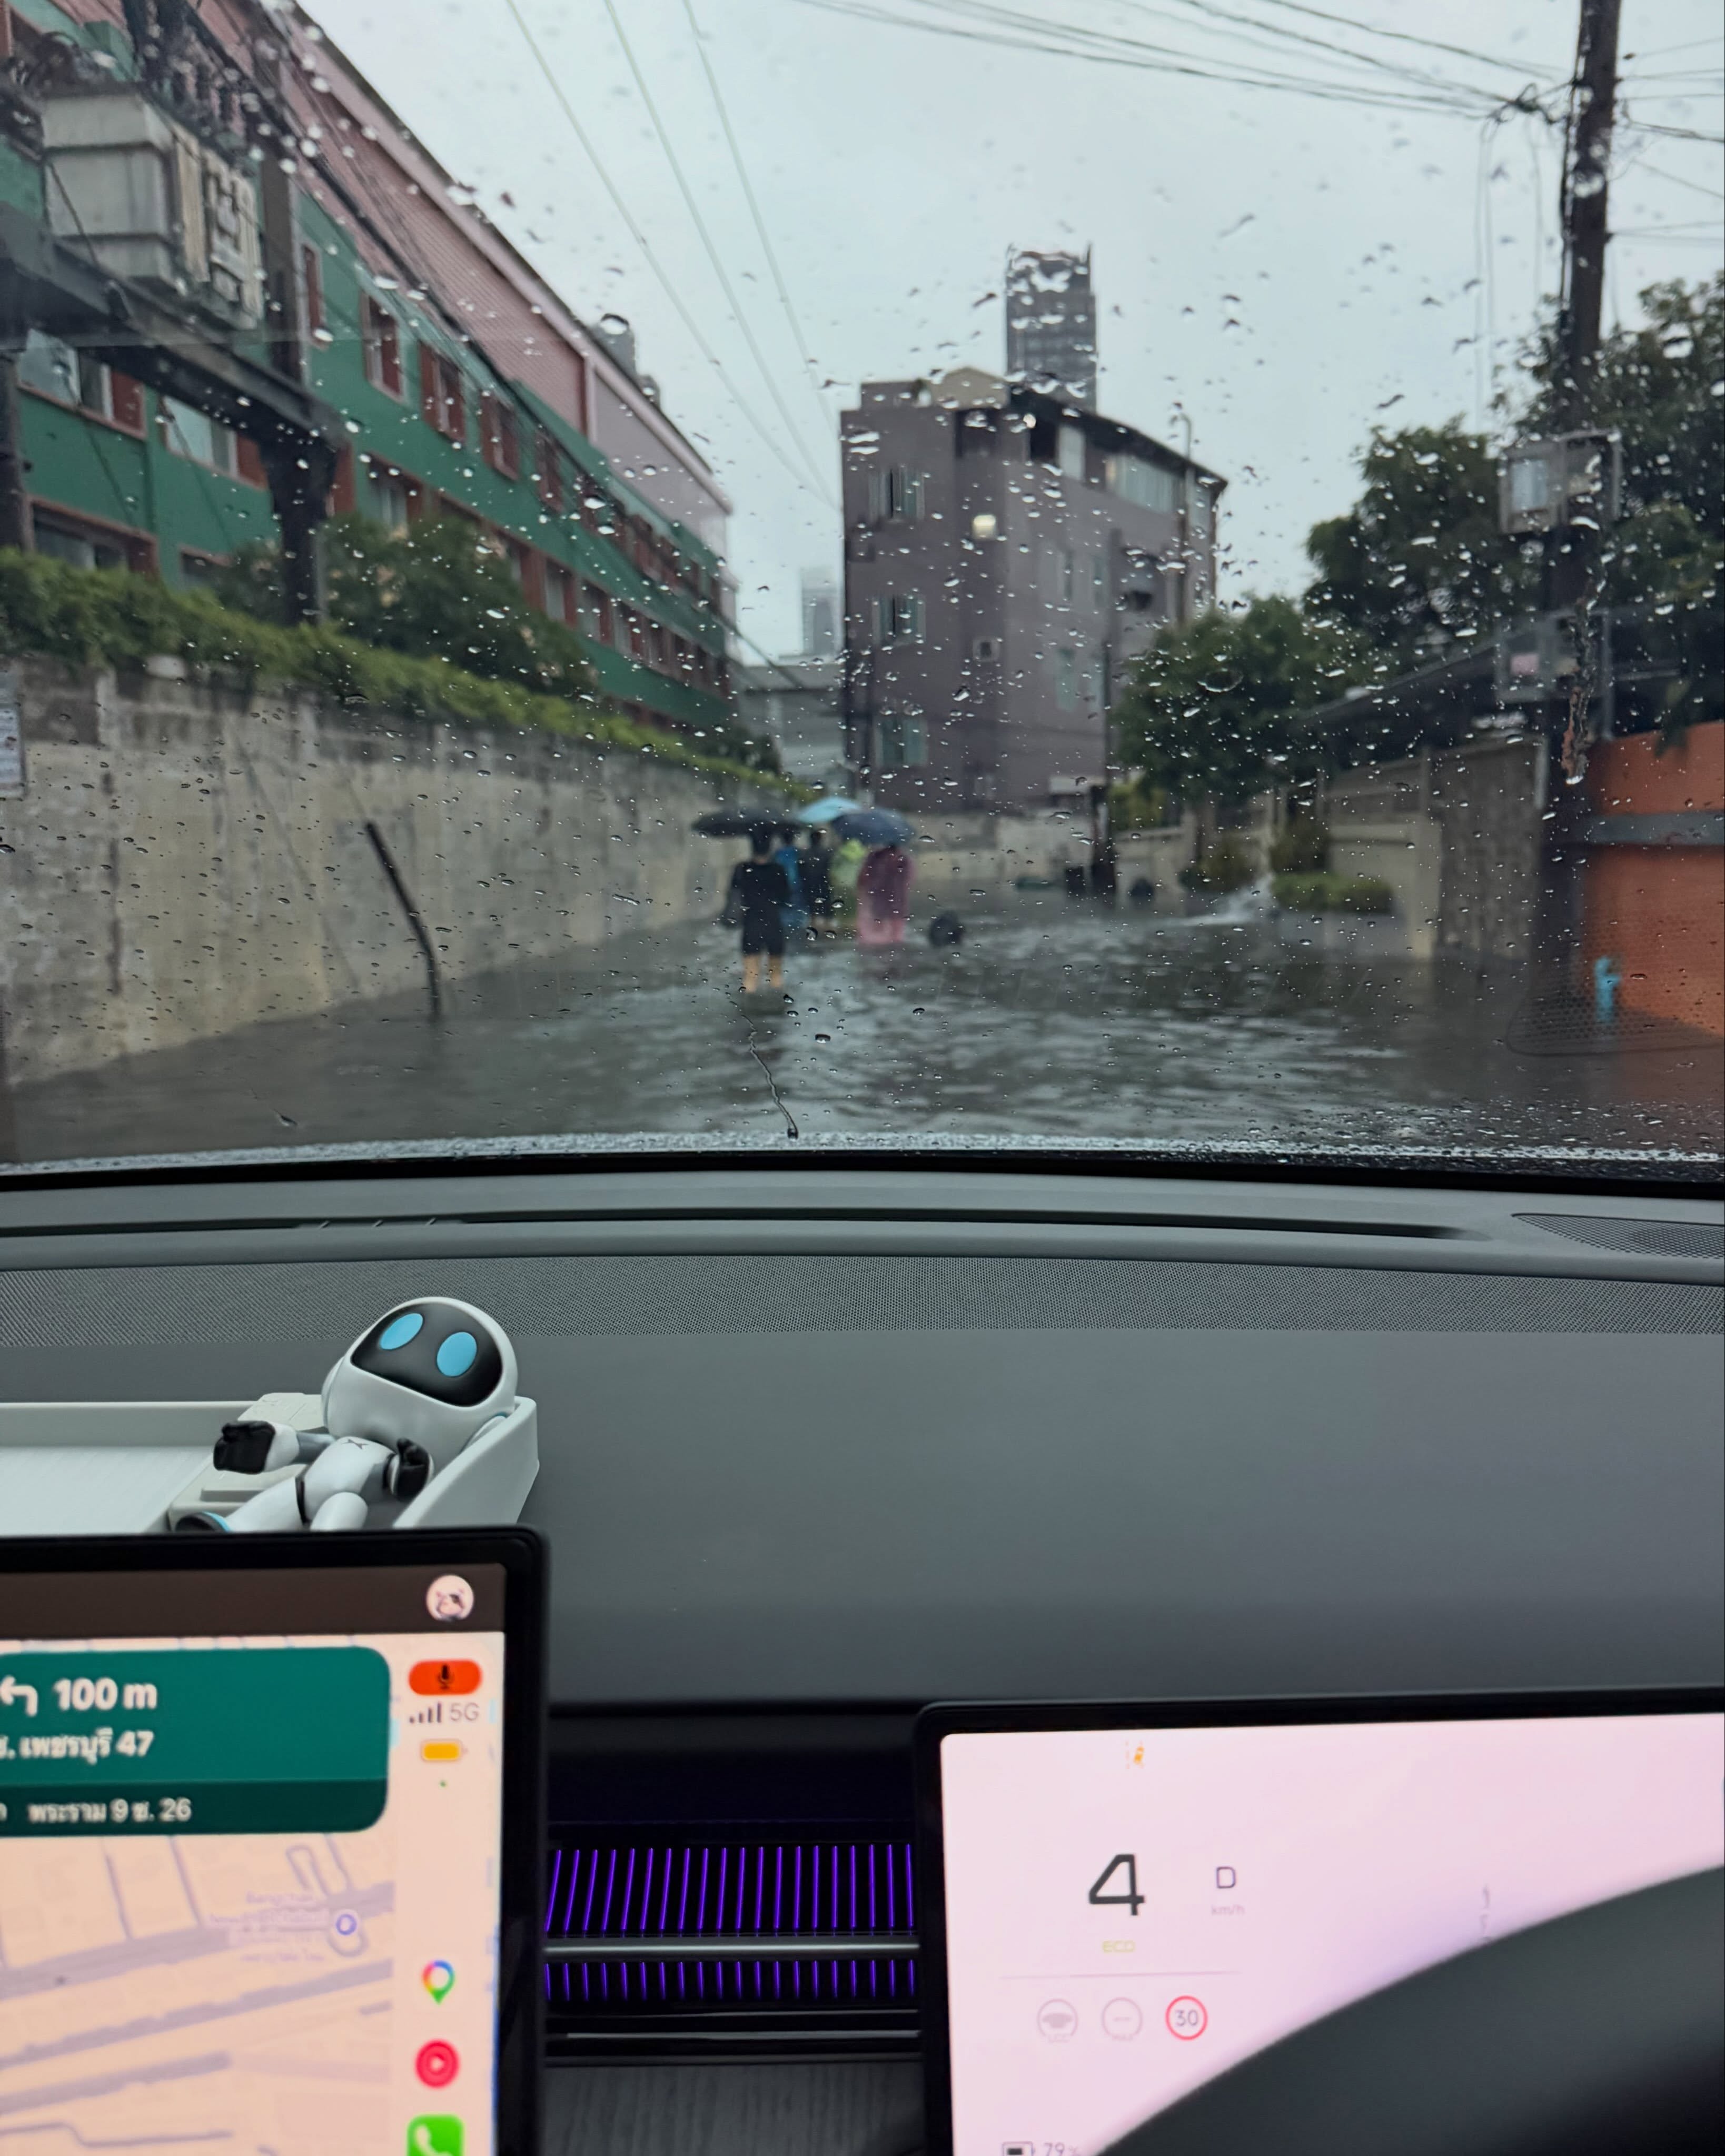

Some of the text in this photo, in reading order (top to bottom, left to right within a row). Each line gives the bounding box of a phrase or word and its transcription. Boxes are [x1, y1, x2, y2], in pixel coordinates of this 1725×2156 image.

[54, 1678, 157, 1710] 100 m
[450, 1702, 480, 1721] 5G
[115, 1730, 154, 1757] 47
[110, 1798, 128, 1823] 9
[159, 1797, 193, 1823] 26
[1088, 1853, 1145, 1916] 4
[1215, 1866, 1236, 1889] D
[1212, 1905, 1245, 1916] km/h
[1102, 1941, 1136, 1954] ECO
[1175, 2010, 1198, 2026] 30
